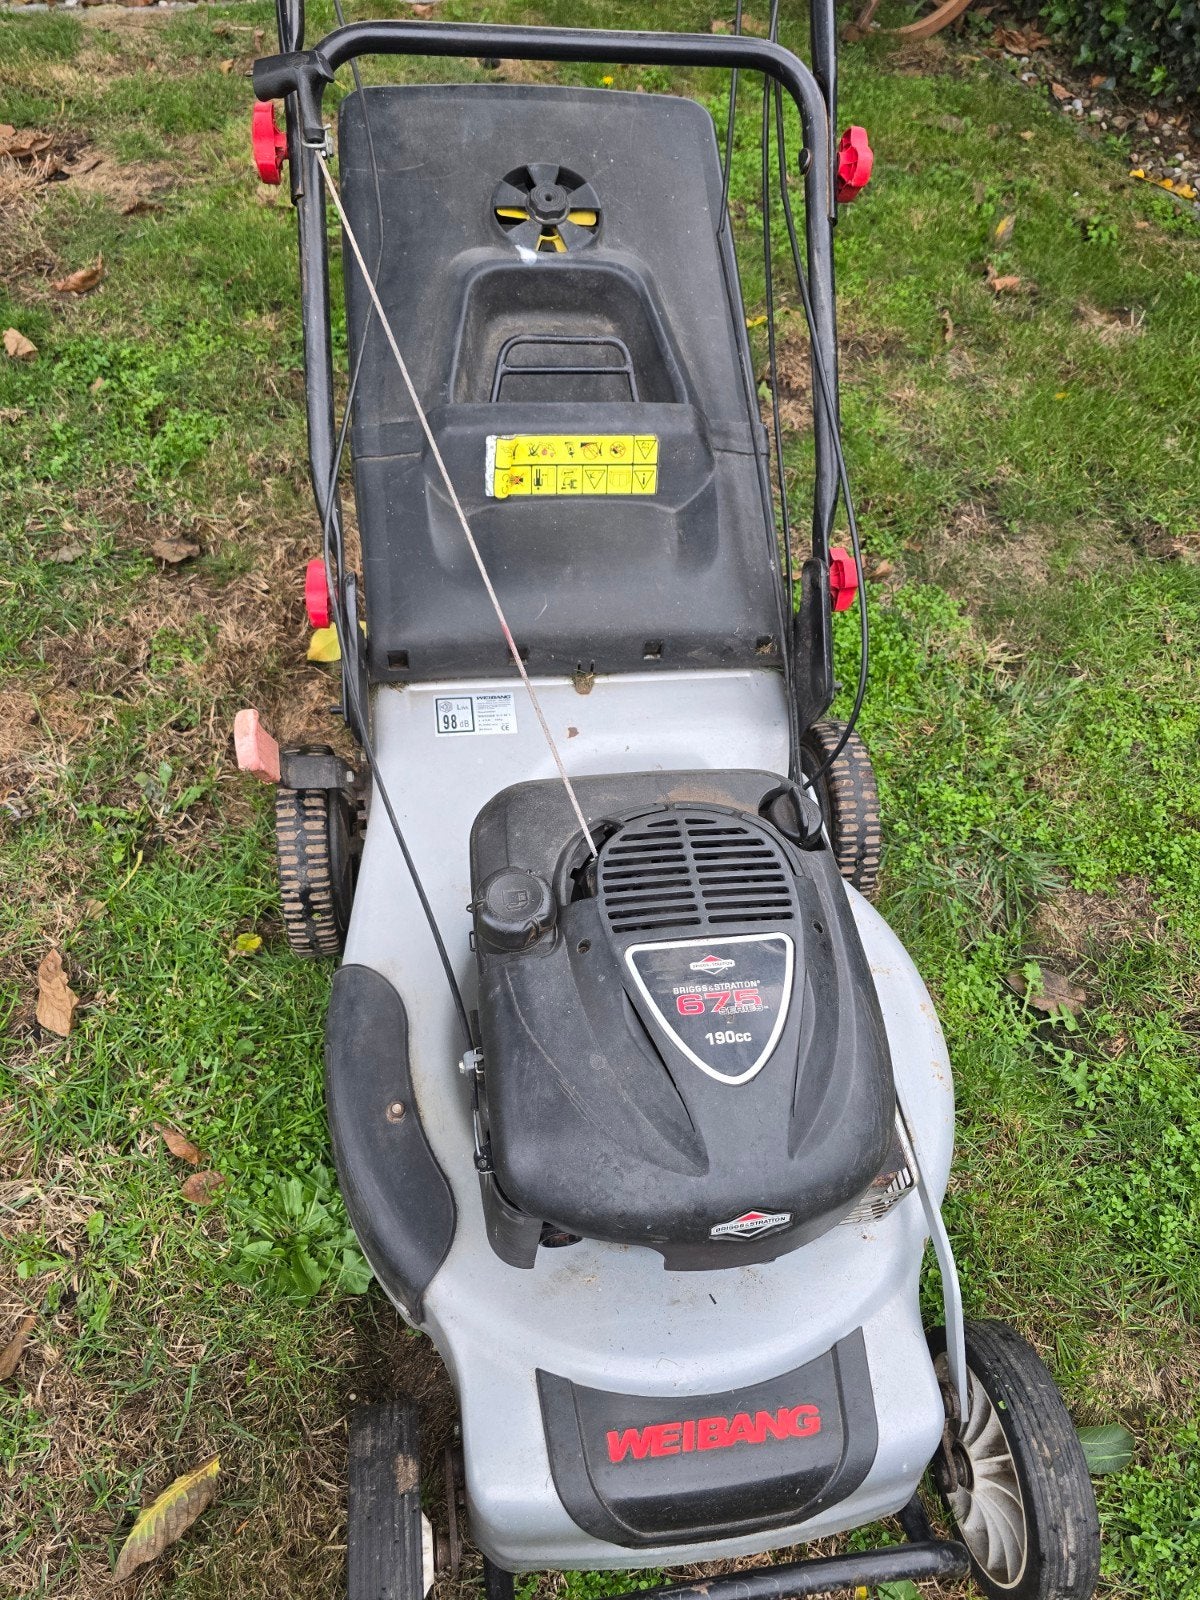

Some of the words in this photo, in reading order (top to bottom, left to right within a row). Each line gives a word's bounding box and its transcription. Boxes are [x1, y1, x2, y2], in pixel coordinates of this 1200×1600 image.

[443, 714, 457, 729] 98
[460, 720, 469, 728] dB
[676, 988, 762, 1016] 675
[719, 1004, 764, 1015] SERIES
[705, 1030, 752, 1045] 190cc
[606, 1404, 822, 1463] WEIBANG
